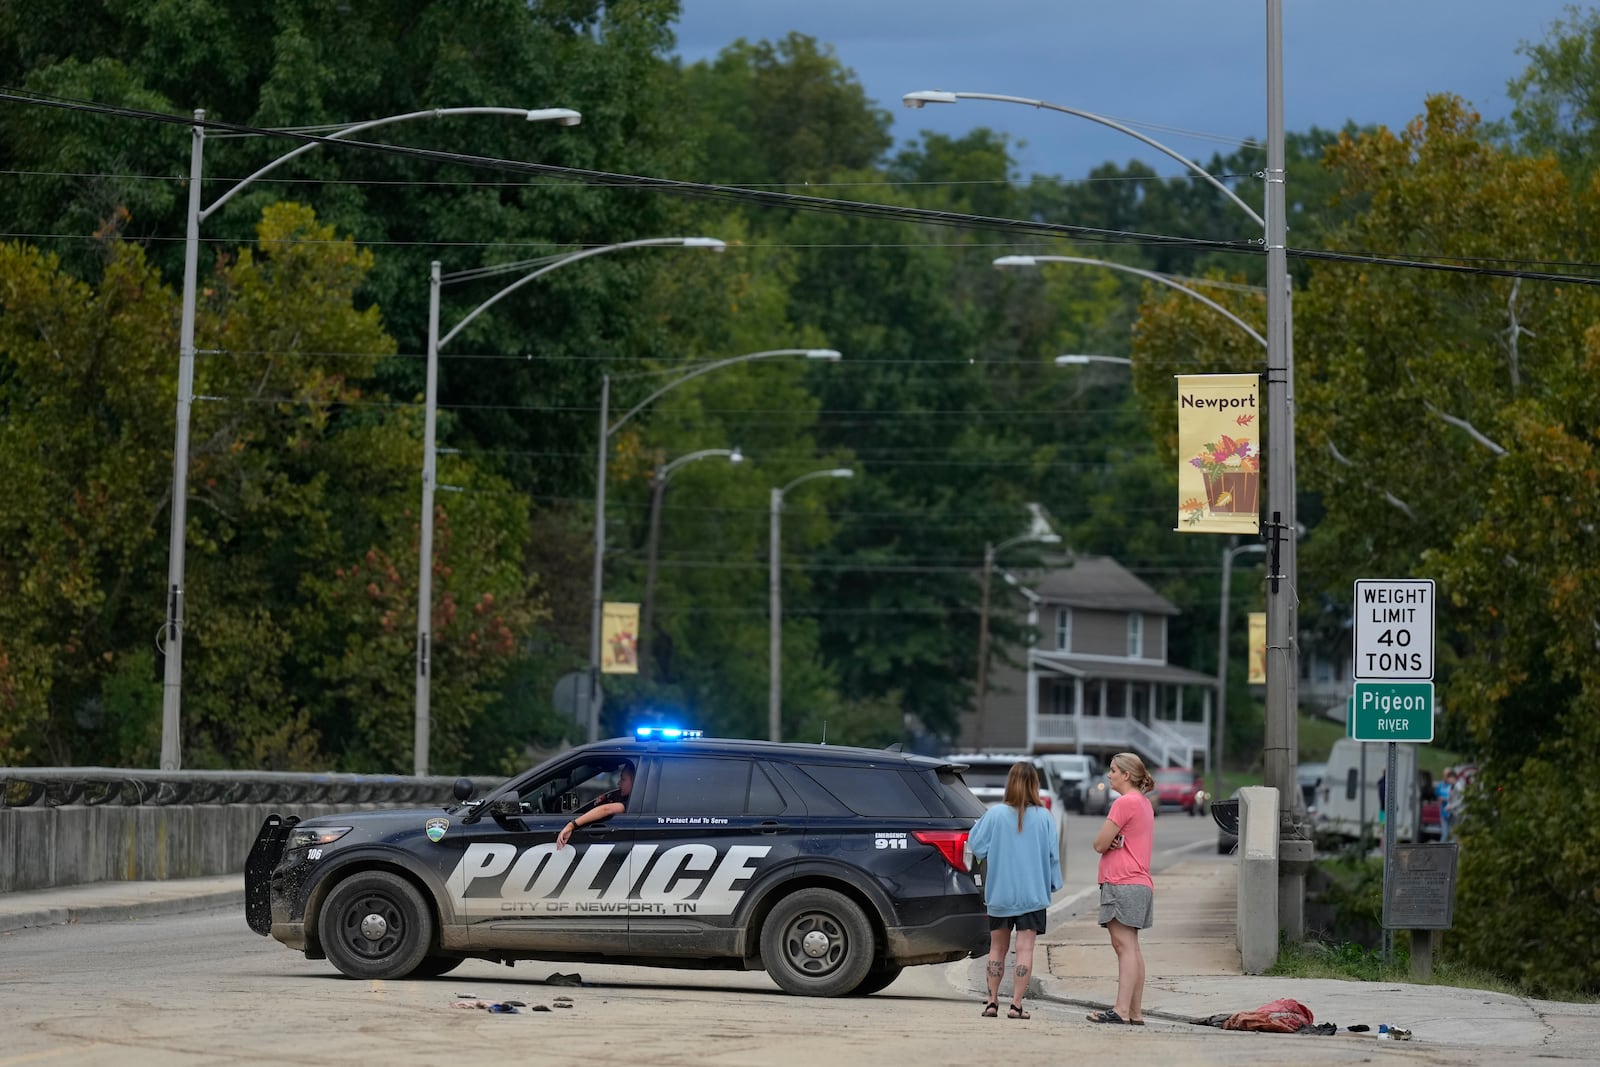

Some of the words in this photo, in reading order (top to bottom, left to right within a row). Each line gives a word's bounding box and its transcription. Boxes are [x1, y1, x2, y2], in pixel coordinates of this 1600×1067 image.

[1181, 393, 1256, 412] Newport
[1364, 588, 1427, 604] WEIGHT
[1372, 608, 1416, 623] LIMIT
[1377, 629, 1411, 647] 40
[1366, 653, 1423, 671] TONS
[1362, 692, 1425, 715] Pigeon
[1378, 719, 1409, 731] RIVER
[875, 838, 908, 849] 911
[307, 848, 323, 860] 106
[444, 842, 773, 902] POLICE
[501, 902, 538, 912] CITY
[546, 902, 569, 912] OF
[575, 902, 667, 914] NEWPORT,
[675, 902, 697, 913] TN
